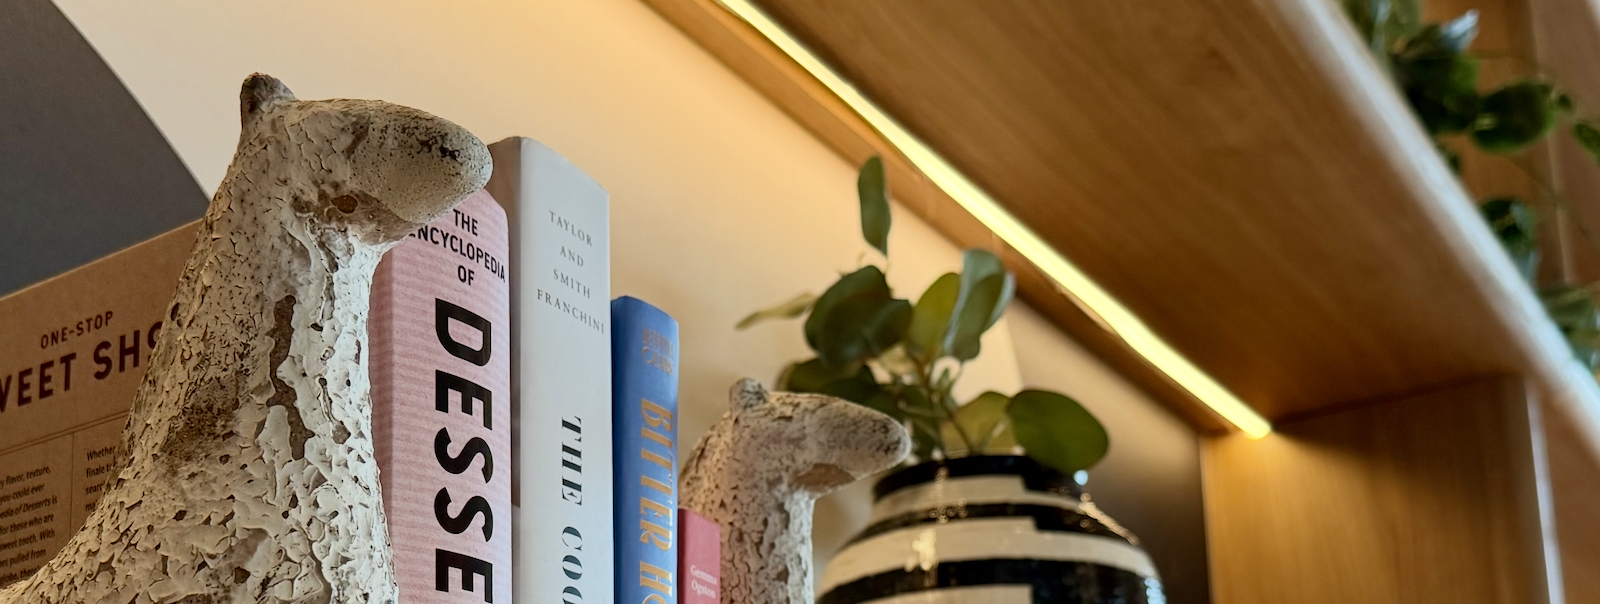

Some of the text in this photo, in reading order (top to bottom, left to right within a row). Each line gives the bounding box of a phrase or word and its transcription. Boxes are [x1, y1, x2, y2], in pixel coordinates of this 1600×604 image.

[453, 209, 478, 236] THE
[549, 210, 592, 247] TAYLOR
[409, 225, 505, 283] NCYCLOPEDIA
[560, 246, 584, 267] AND
[457, 265, 475, 286] OF
[553, 269, 591, 299] SMITH
[537, 289, 604, 334] FRANCHINI
[40, 310, 113, 349] ONE-STOP
[86, 446, 116, 461] Whether
[434, 297, 493, 604] DESSE
[561, 415, 582, 506] THE
[26, 466, 51, 480] texture,
[86, 465, 105, 478] finale
[640, 398, 673, 551] BITTER
[15, 503, 22, 515] of
[23, 499, 51, 513] Desserts
[52, 495, 58, 505] is
[10, 522, 28, 533] those
[29, 516, 42, 528] who
[43, 514, 54, 524] are
[40, 528, 55, 540] With
[31, 549, 46, 560] from
[690, 564, 718, 586] Gemma
[691, 579, 717, 600] Ogston
